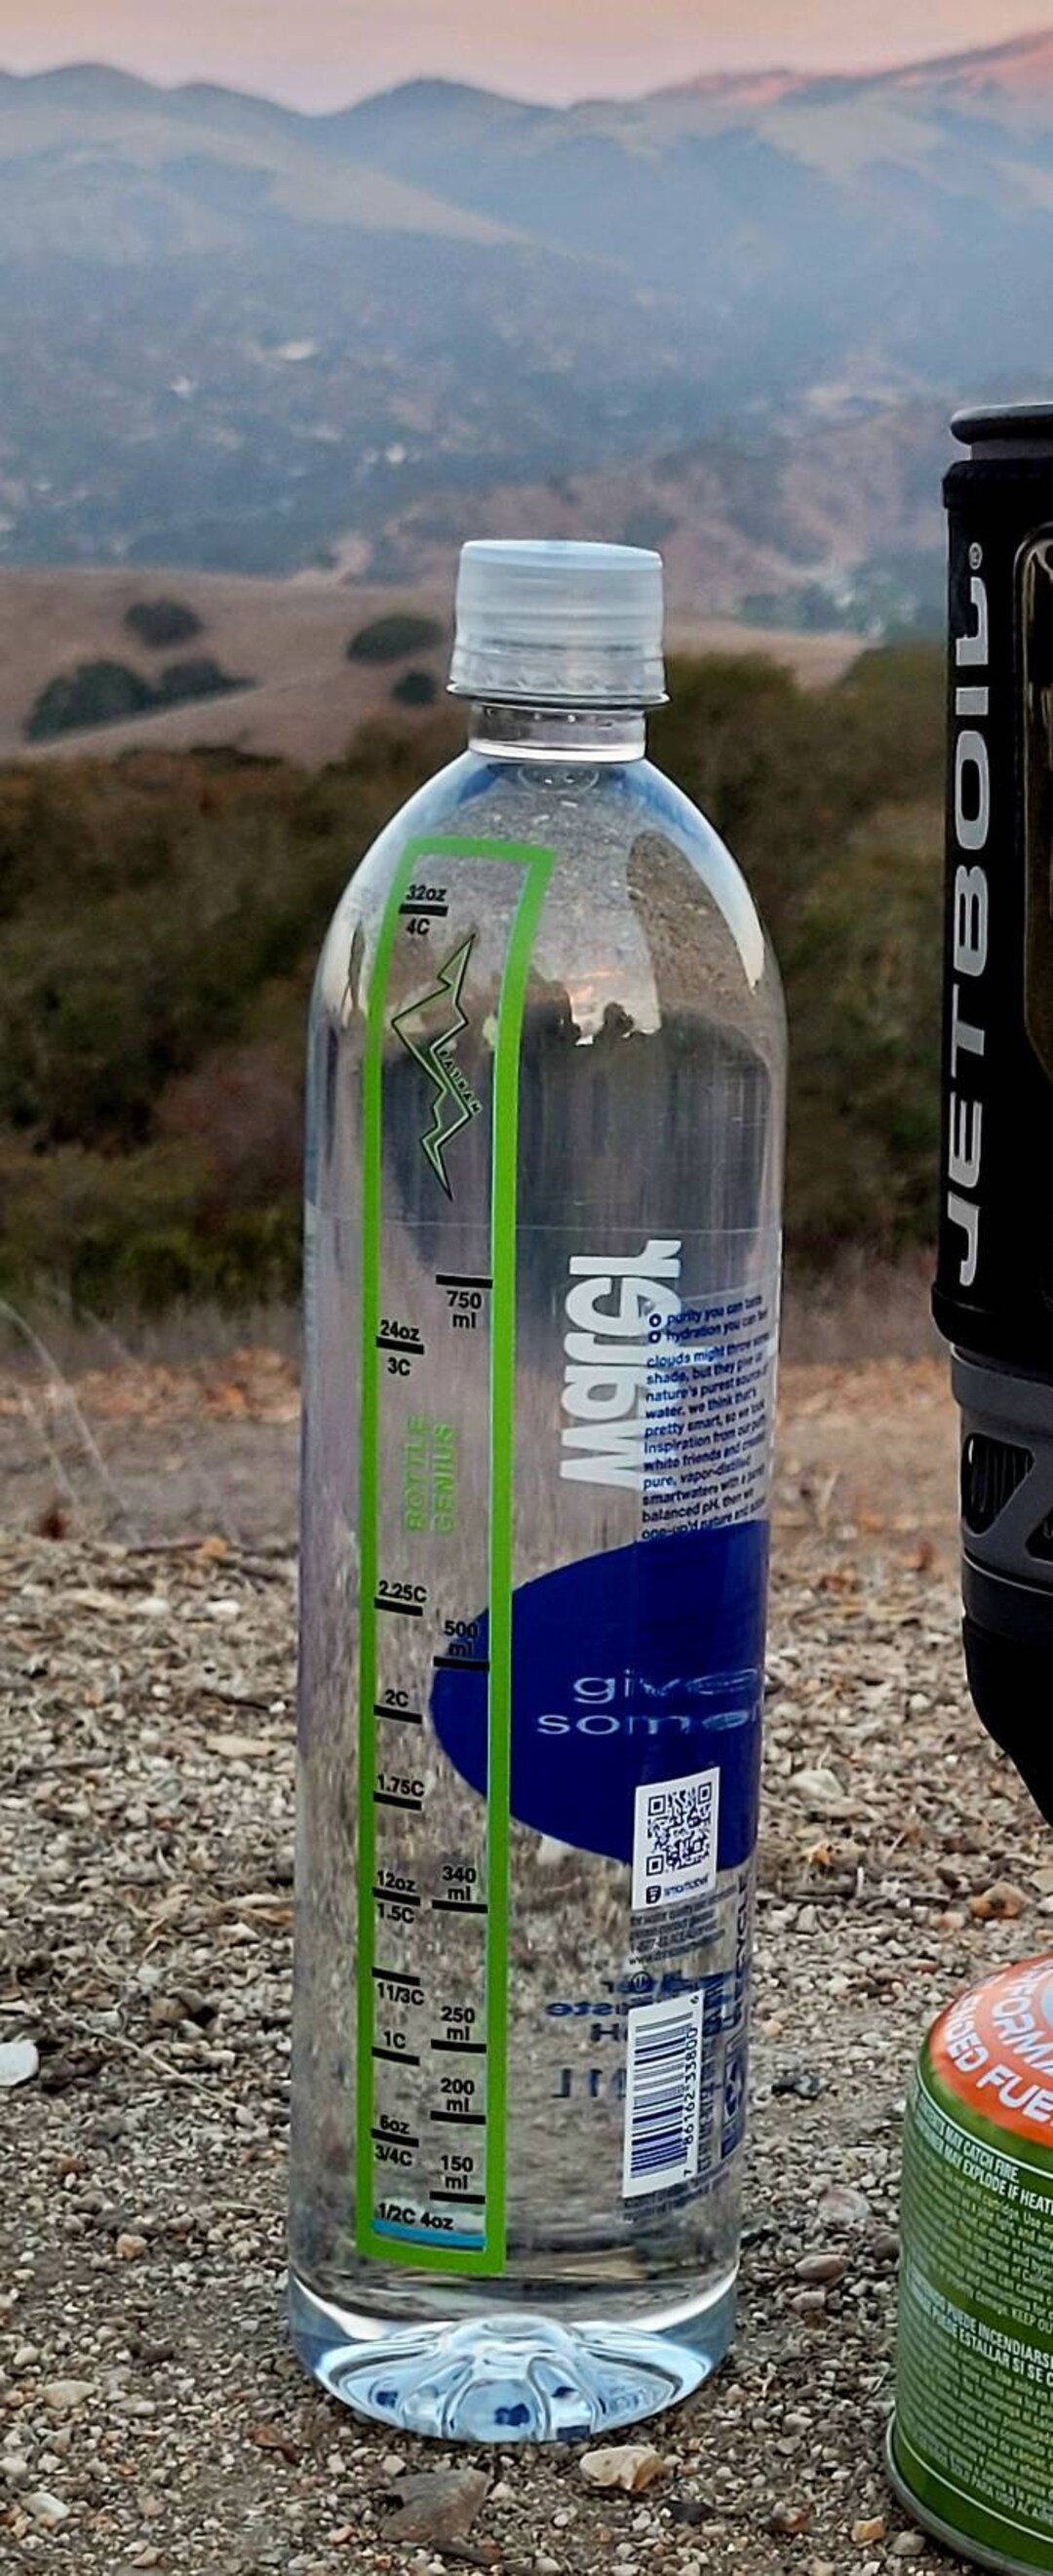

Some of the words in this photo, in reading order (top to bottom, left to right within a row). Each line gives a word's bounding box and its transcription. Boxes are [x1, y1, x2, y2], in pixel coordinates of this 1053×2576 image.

[406, 884, 447, 902] 32oz
[406, 918, 431, 935] 4C
[947, 576, 990, 1287] JETBOIL
[447, 1290, 482, 1308] 750
[452, 1312, 476, 1328] ml
[380, 1319, 420, 1341] 24oz
[667, 1324, 721, 1344] hydration
[387, 1356, 410, 1376] 3C
[646, 1351, 690, 1368] clouds
[645, 1385, 698, 1401] nature's
[644, 1422, 683, 1439] pretty
[644, 1433, 711, 1454] inspiration
[405, 1414, 427, 1533] BOTTLE
[644, 1457, 681, 1472] white
[432, 1423, 456, 1535] GENIUS
[643, 1503, 700, 1523] balanced
[445, 1620, 478, 1638] 500
[448, 1642, 473, 1656] ml
[384, 1689, 410, 1707] 2C
[377, 1775, 425, 1797] 1.75C
[377, 1870, 416, 1893] 12oz
[443, 1866, 477, 1883] 340
[448, 1886, 471, 1900] ml
[377, 1903, 415, 1924] 1.5C
[441, 2006, 475, 2023] 250
[383, 2030, 406, 2049] 1C
[447, 2026, 470, 2041] ml
[441, 2078, 475, 2095] 200
[976, 2063, 1053, 2127] FUE
[446, 2097, 470, 2112] ml
[380, 2115, 410, 2134] 6oz
[375, 2145, 412, 2166] 3/4C
[441, 2155, 474, 2172] 150
[963, 2140, 994, 2170] CATCH
[446, 2175, 468, 2190] ml
[962, 2160, 1007, 2196] EXPLODE
[1007, 2184, 1020, 2202] IF
[1020, 2188, 1053, 2217] HEAT
[378, 2203, 416, 2225] 1/2C
[420, 2211, 454, 2231] 4oz
[1011, 2309, 1037, 2326] KEEP
[958, 2326, 1011, 2368] ESTALLAR
[1012, 2356, 1025, 2375] SI
[1027, 2363, 1045, 2384] SE
